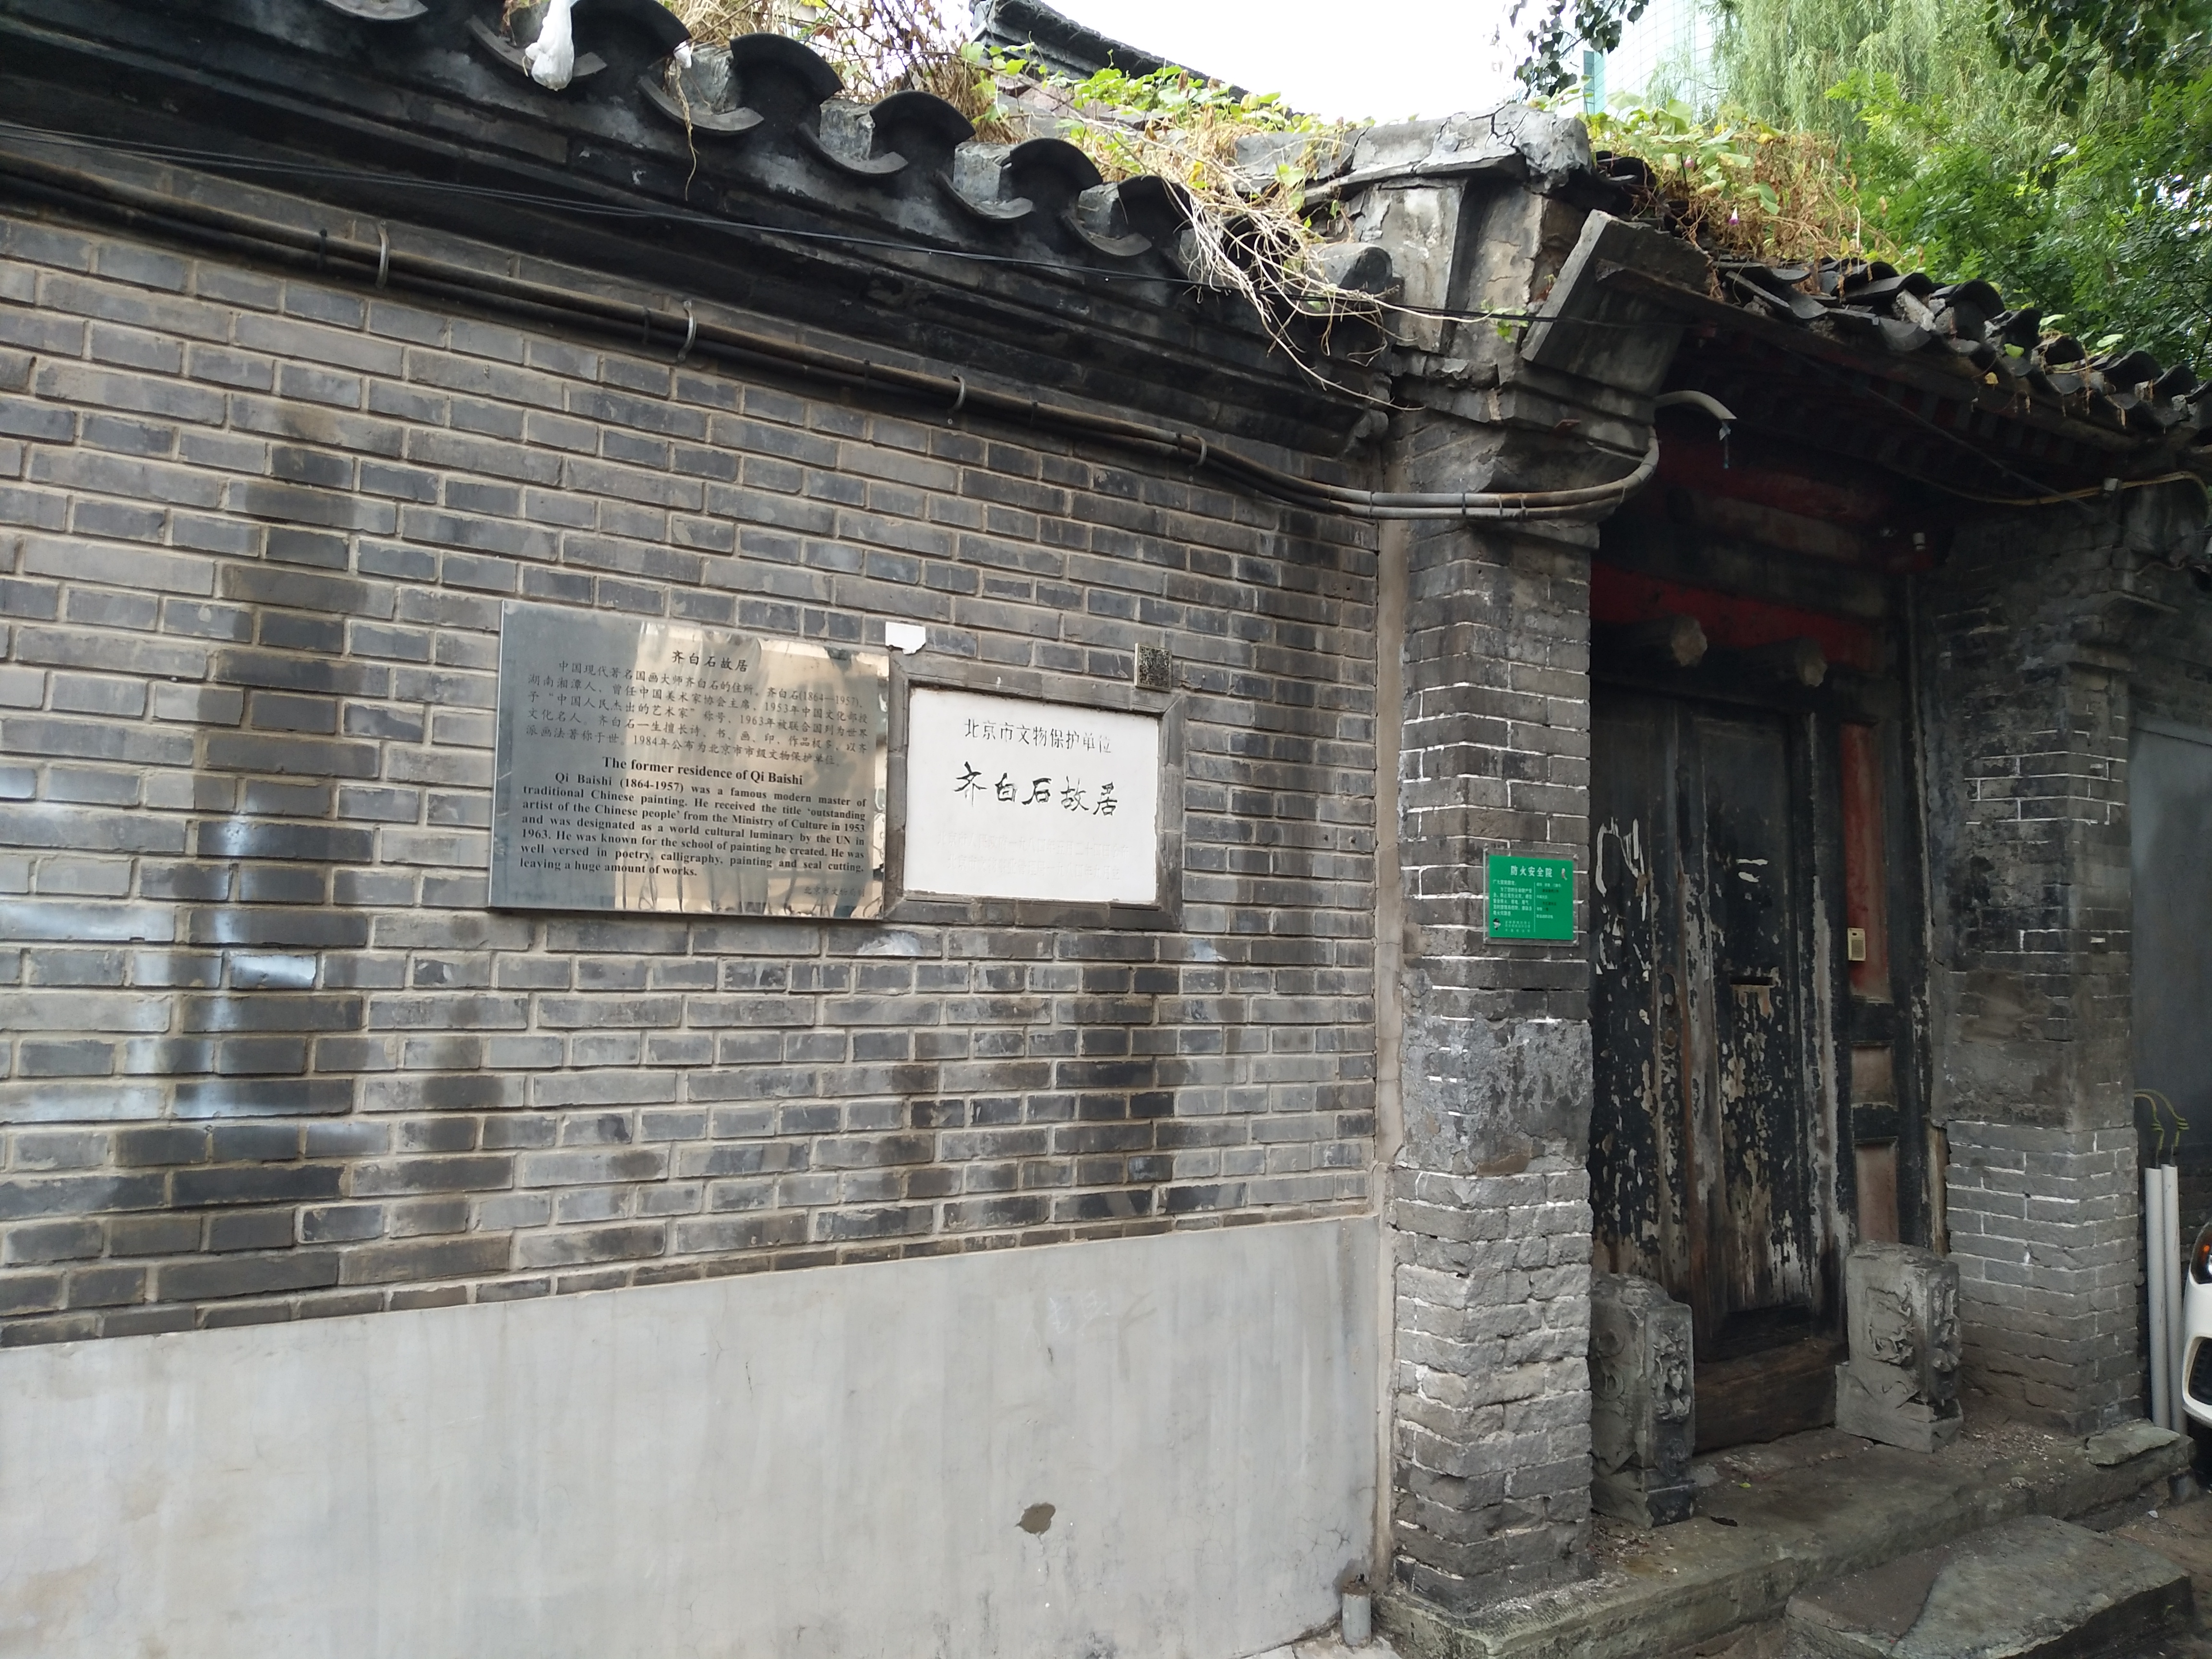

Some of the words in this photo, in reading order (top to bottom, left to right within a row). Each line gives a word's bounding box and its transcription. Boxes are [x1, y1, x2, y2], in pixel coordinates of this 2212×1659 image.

[672, 650, 747, 672] 齐白石故居
[964, 718, 1111, 753] 北京市文物保护单位
[603, 757, 626, 769] The
[631, 759, 674, 773] former
[678, 766, 733, 779] residence
[736, 770, 748, 780] of
[751, 770, 764, 783] Qi
[768, 772, 803, 785] Baishi
[524, 786, 584, 798] traditional
[591, 790, 634, 802] Chinese
[641, 795, 687, 807] painting.
[695, 798, 709, 807] He
[715, 801, 756, 811] received
[762, 804, 777, 813] the
[782, 805, 802, 815] title
[555, 772, 569, 784] Qi
[577, 774, 612, 786] Baishi
[620, 778, 684, 793] (1864-1957)
[731, 787, 767, 799] famous
[774, 793, 811, 803] modern
[818, 796, 851, 806] master
[857, 799, 867, 807] of
[953, 761, 1118, 816] 齐白石故居
[522, 815, 543, 824] and
[577, 817, 635, 830] designated
[670, 825, 699, 834] world
[705, 828, 744, 837] cultural
[750, 830, 793, 843] luminary
[800, 833, 811, 844] by
[817, 834, 831, 844] the
[836, 835, 851, 845] UN
[856, 837, 864, 845] in
[523, 800, 553, 810] artist
[558, 802, 570, 811] of
[574, 803, 590, 813] the
[595, 805, 637, 816] Chinese
[684, 811, 708, 821] from
[712, 814, 728, 823] the
[732, 815, 773, 828] Ministry
[778, 819, 788, 827] of
[792, 819, 828, 830] Culture
[831, 822, 840, 831] in
[844, 823, 865, 832] 1953
[521, 844, 544, 854] well
[553, 847, 589, 856] versed
[597, 847, 607, 857] in
[730, 857, 772, 868] painting
[779, 860, 797, 868] and
[803, 861, 822, 869] seal
[522, 829, 551, 839] 1963.
[557, 830, 572, 840] He
[577, 834, 597, 842] was
[601, 833, 637, 844] known
[642, 836, 657, 845] for
[661, 837, 677, 847] the
[681, 839, 713, 849] school
[717, 841, 728, 850] of
[730, 842, 771, 854] painting
[775, 845, 786, 854] he
[790, 848, 828, 856] created.
[831, 848, 844, 857] He
[520, 857, 561, 871] leaving
[575, 861, 601, 873] huge
[604, 864, 646, 873] amount
[649, 865, 661, 874] of
[663, 866, 697, 876] works.
[1510, 865, 1553, 878] 防火安全院
